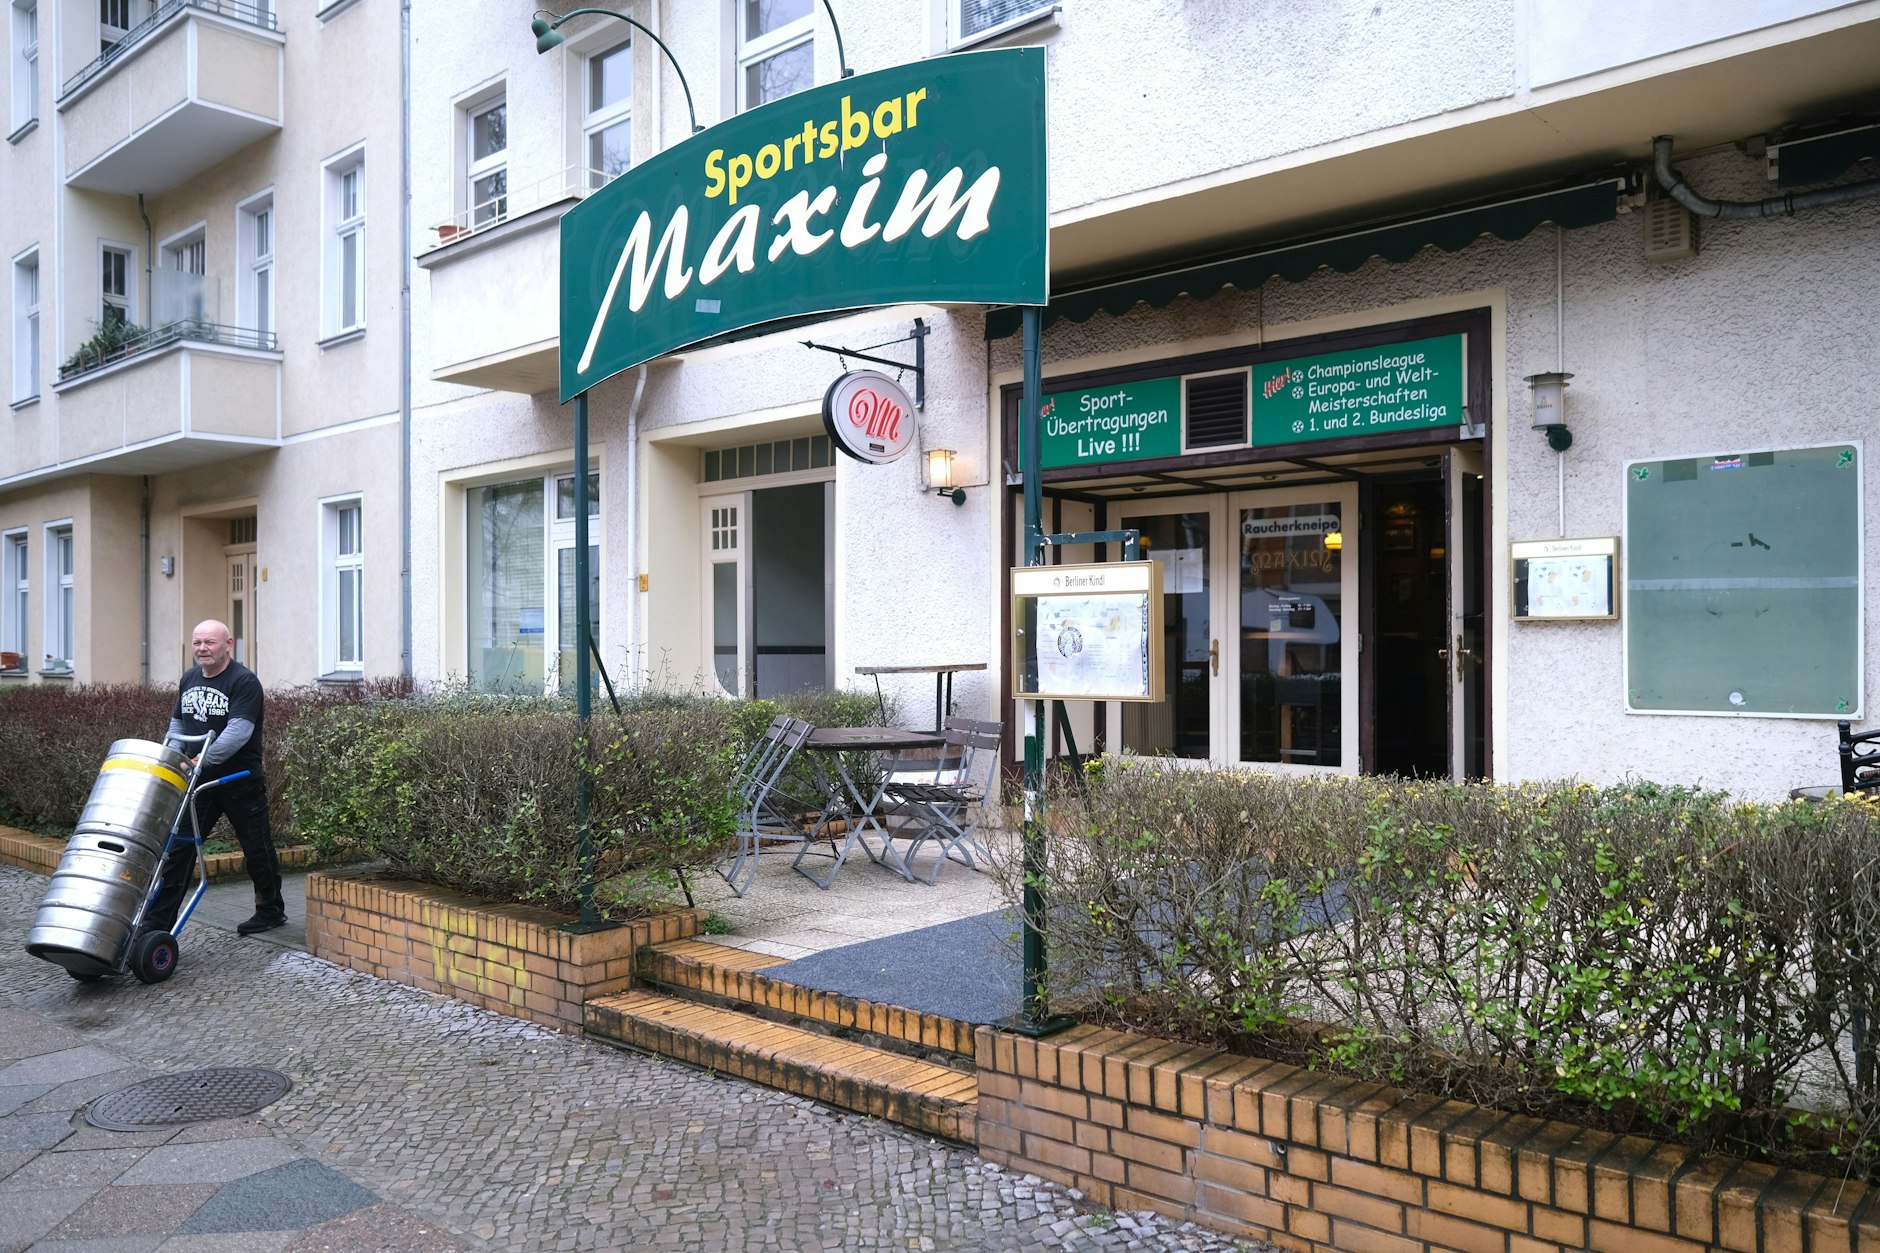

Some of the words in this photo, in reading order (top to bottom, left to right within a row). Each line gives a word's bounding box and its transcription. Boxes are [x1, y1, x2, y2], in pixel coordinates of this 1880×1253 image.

[704, 87, 926, 206] Sportsbar
[576, 152, 1000, 375] Maxim
[1307, 353, 1425, 380] Championsleague
[1263, 366, 1292, 399] Hier!
[1308, 380, 1361, 397] Europa-
[1365, 372, 1391, 389] und
[1395, 367, 1439, 384] Welt-
[1080, 390, 1133, 416] Sport-
[1308, 388, 1428, 414] Meisterschaften
[1047, 409, 1168, 436] Übertragungen
[1309, 417, 1319, 431] 1.
[1323, 415, 1348, 430] und
[1352, 413, 1365, 427] 2.
[1370, 404, 1447, 425] Bundesliga
[1077, 438, 1116, 457] Live
[1122, 432, 1140, 453] !!!
[1244, 518, 1338, 535] Raucherkneipe
[1065, 575, 1088, 587] Berliner
[1088, 574, 1105, 586] Kindl
